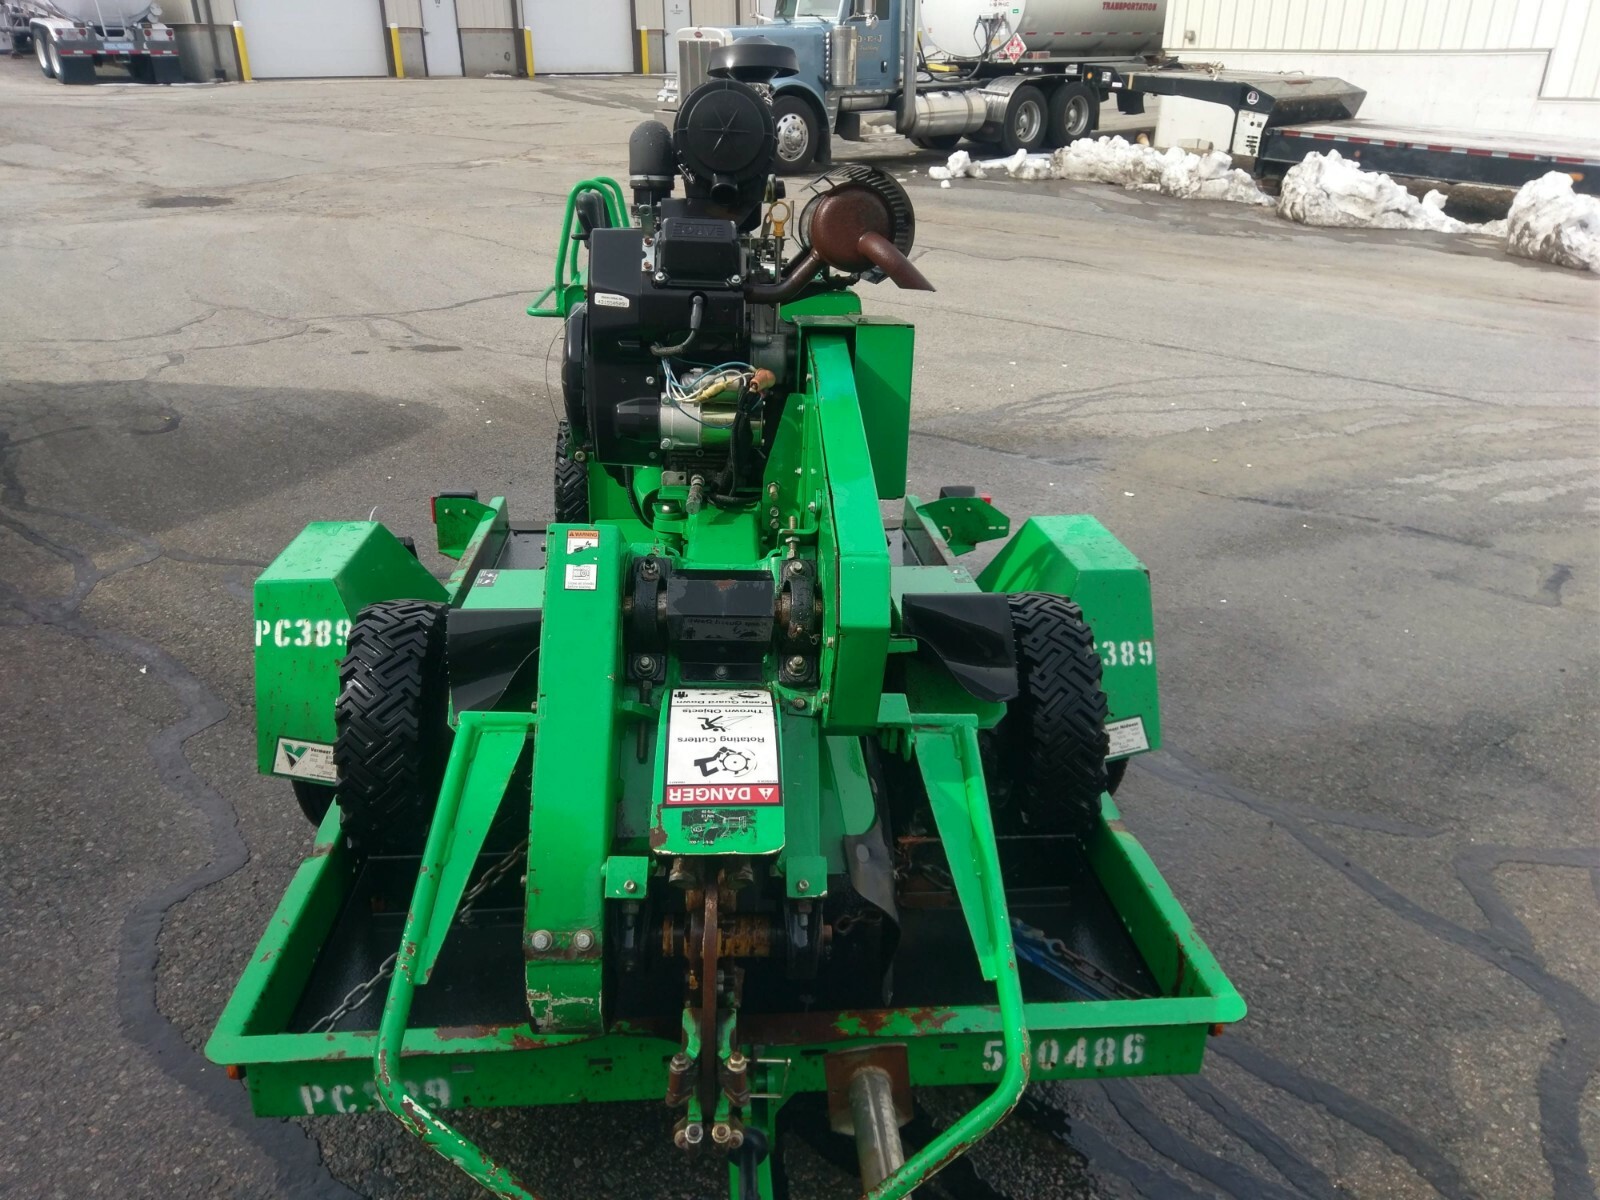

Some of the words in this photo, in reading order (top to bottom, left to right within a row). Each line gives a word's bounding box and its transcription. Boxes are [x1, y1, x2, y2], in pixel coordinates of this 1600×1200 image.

[1102, 2, 1158, 11] TRANSPORTATION
[255, 618, 353, 648] PC389
[1093, 640, 1153, 666] 389
[719, 735, 765, 744] Rotating
[310, 746, 332, 755] Vermeer
[669, 787, 751, 802] DANGER
[981, 1033, 1146, 1072] 50486
